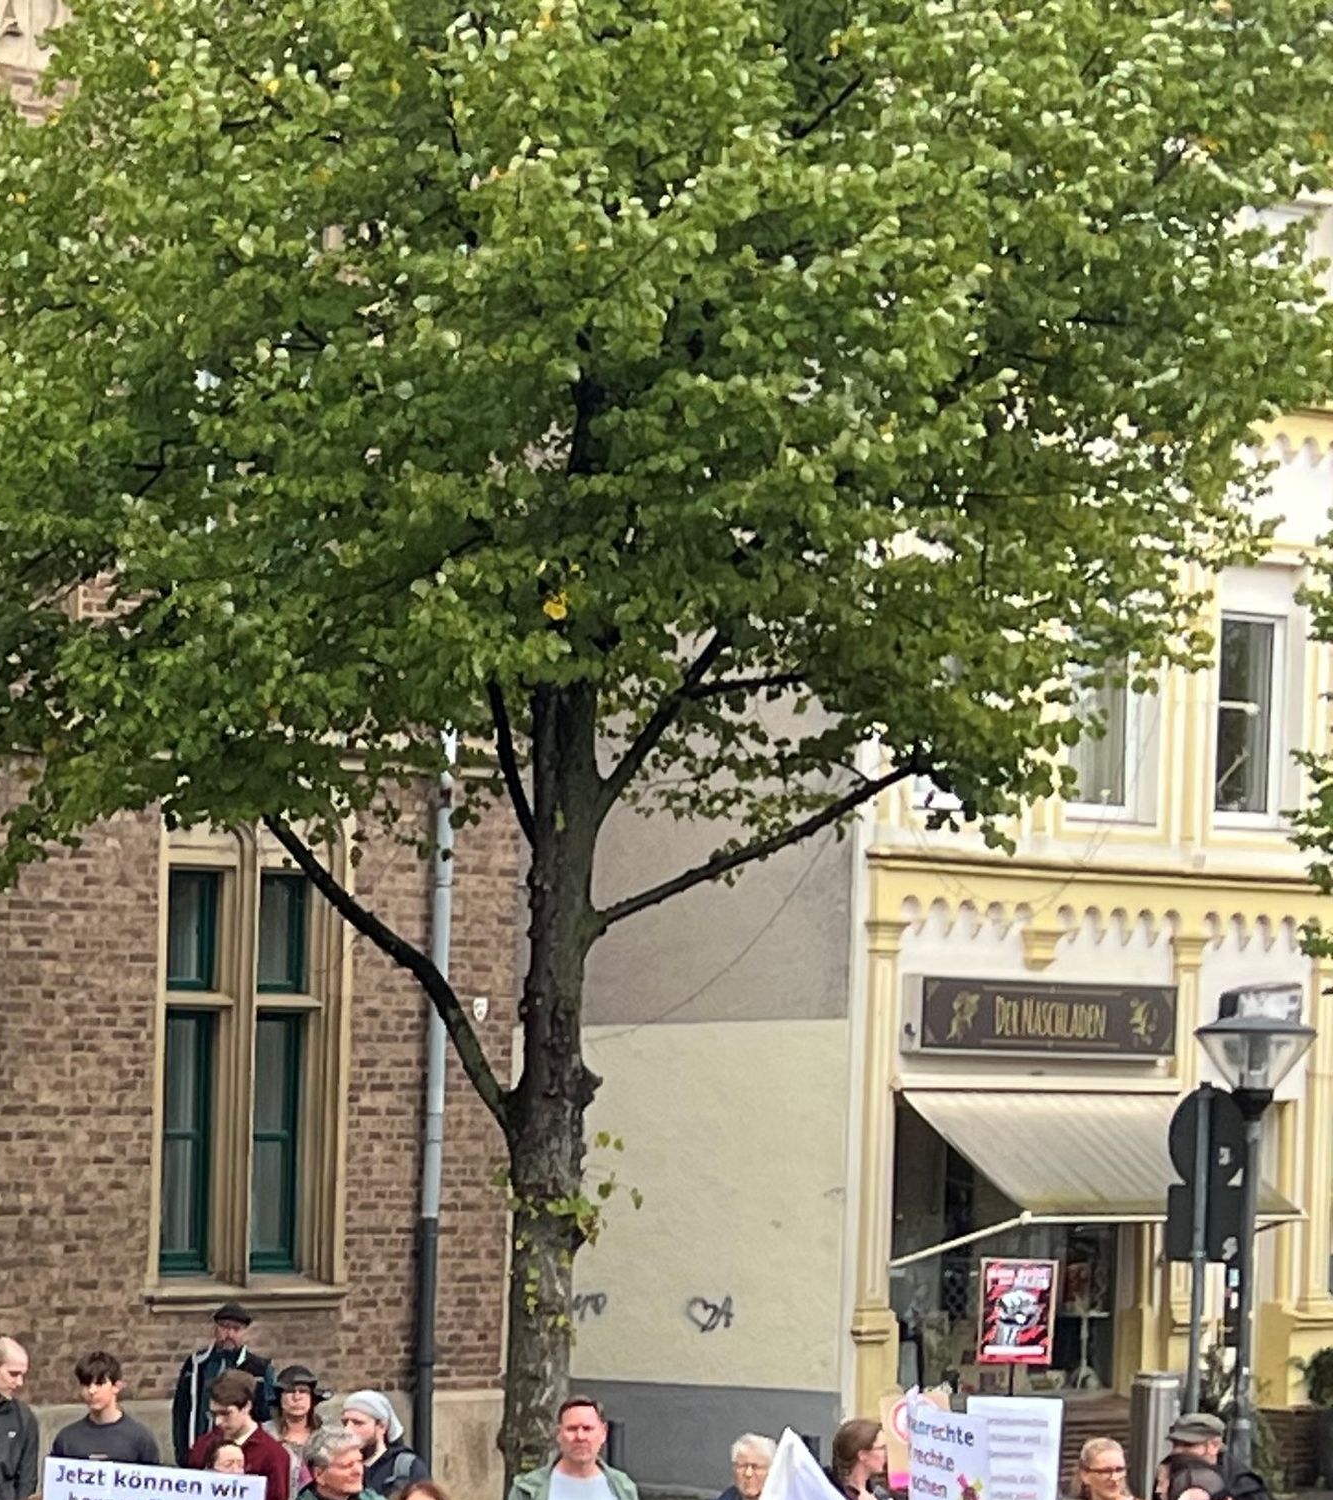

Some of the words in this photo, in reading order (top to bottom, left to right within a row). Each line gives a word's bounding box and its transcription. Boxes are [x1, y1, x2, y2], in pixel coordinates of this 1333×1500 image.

[56, 1464, 106, 1486] Jetzt
[114, 1470, 202, 1495] können
[211, 1480, 249, 1499] wir
